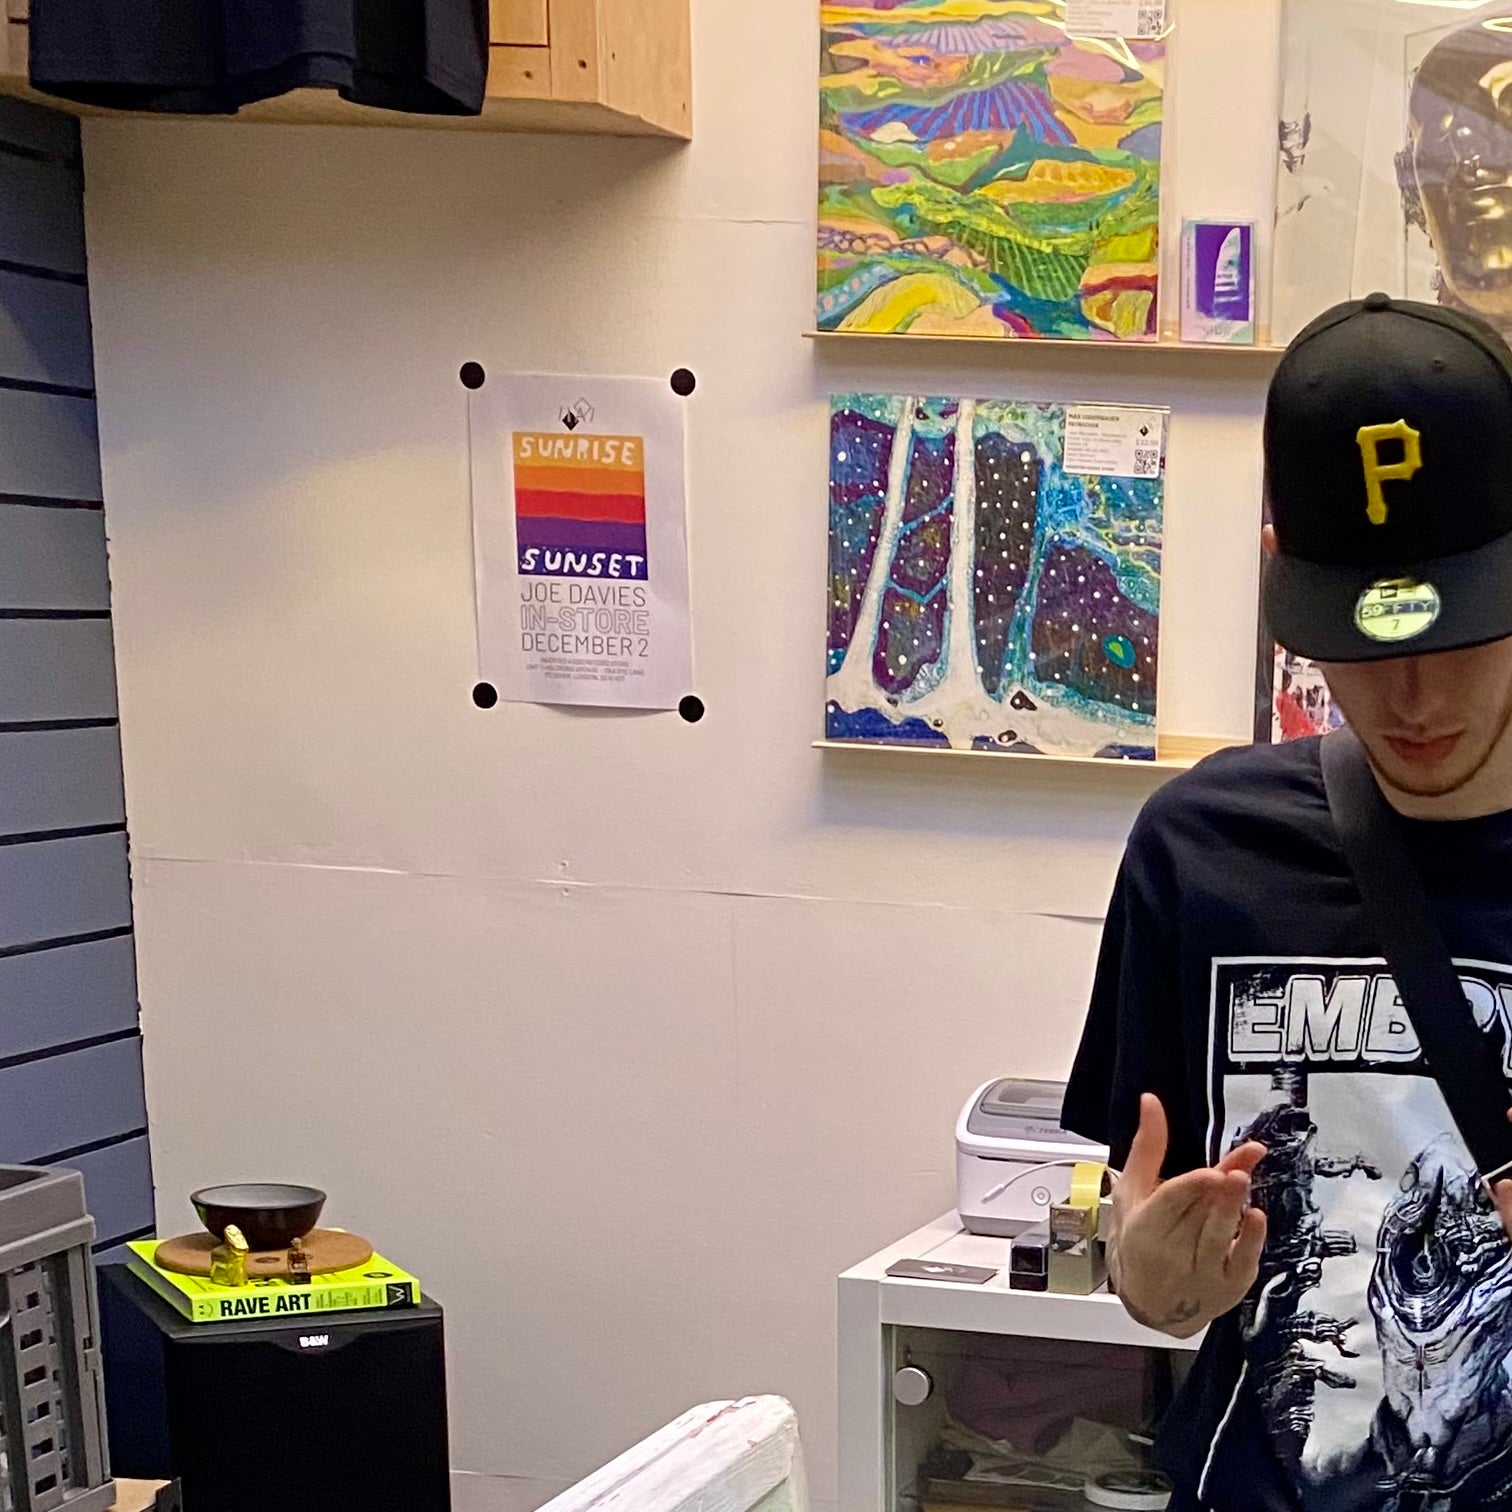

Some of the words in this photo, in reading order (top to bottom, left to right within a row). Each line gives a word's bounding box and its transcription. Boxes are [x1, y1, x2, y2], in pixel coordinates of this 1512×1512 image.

[519, 436, 635, 465] SUNRISE
[1356, 419, 1422, 525] P
[520, 548, 644, 577] SUNSET
[521, 582, 561, 603] JOE
[569, 584, 646, 607] DAVIES
[521, 604, 650, 635] IN-STORE
[1392, 619, 1400, 631] 7
[522, 632, 632, 656] DECEMBER
[638, 638, 649, 658] 2
[220, 1297, 270, 1317] RAVE
[276, 1294, 311, 1312] ART
